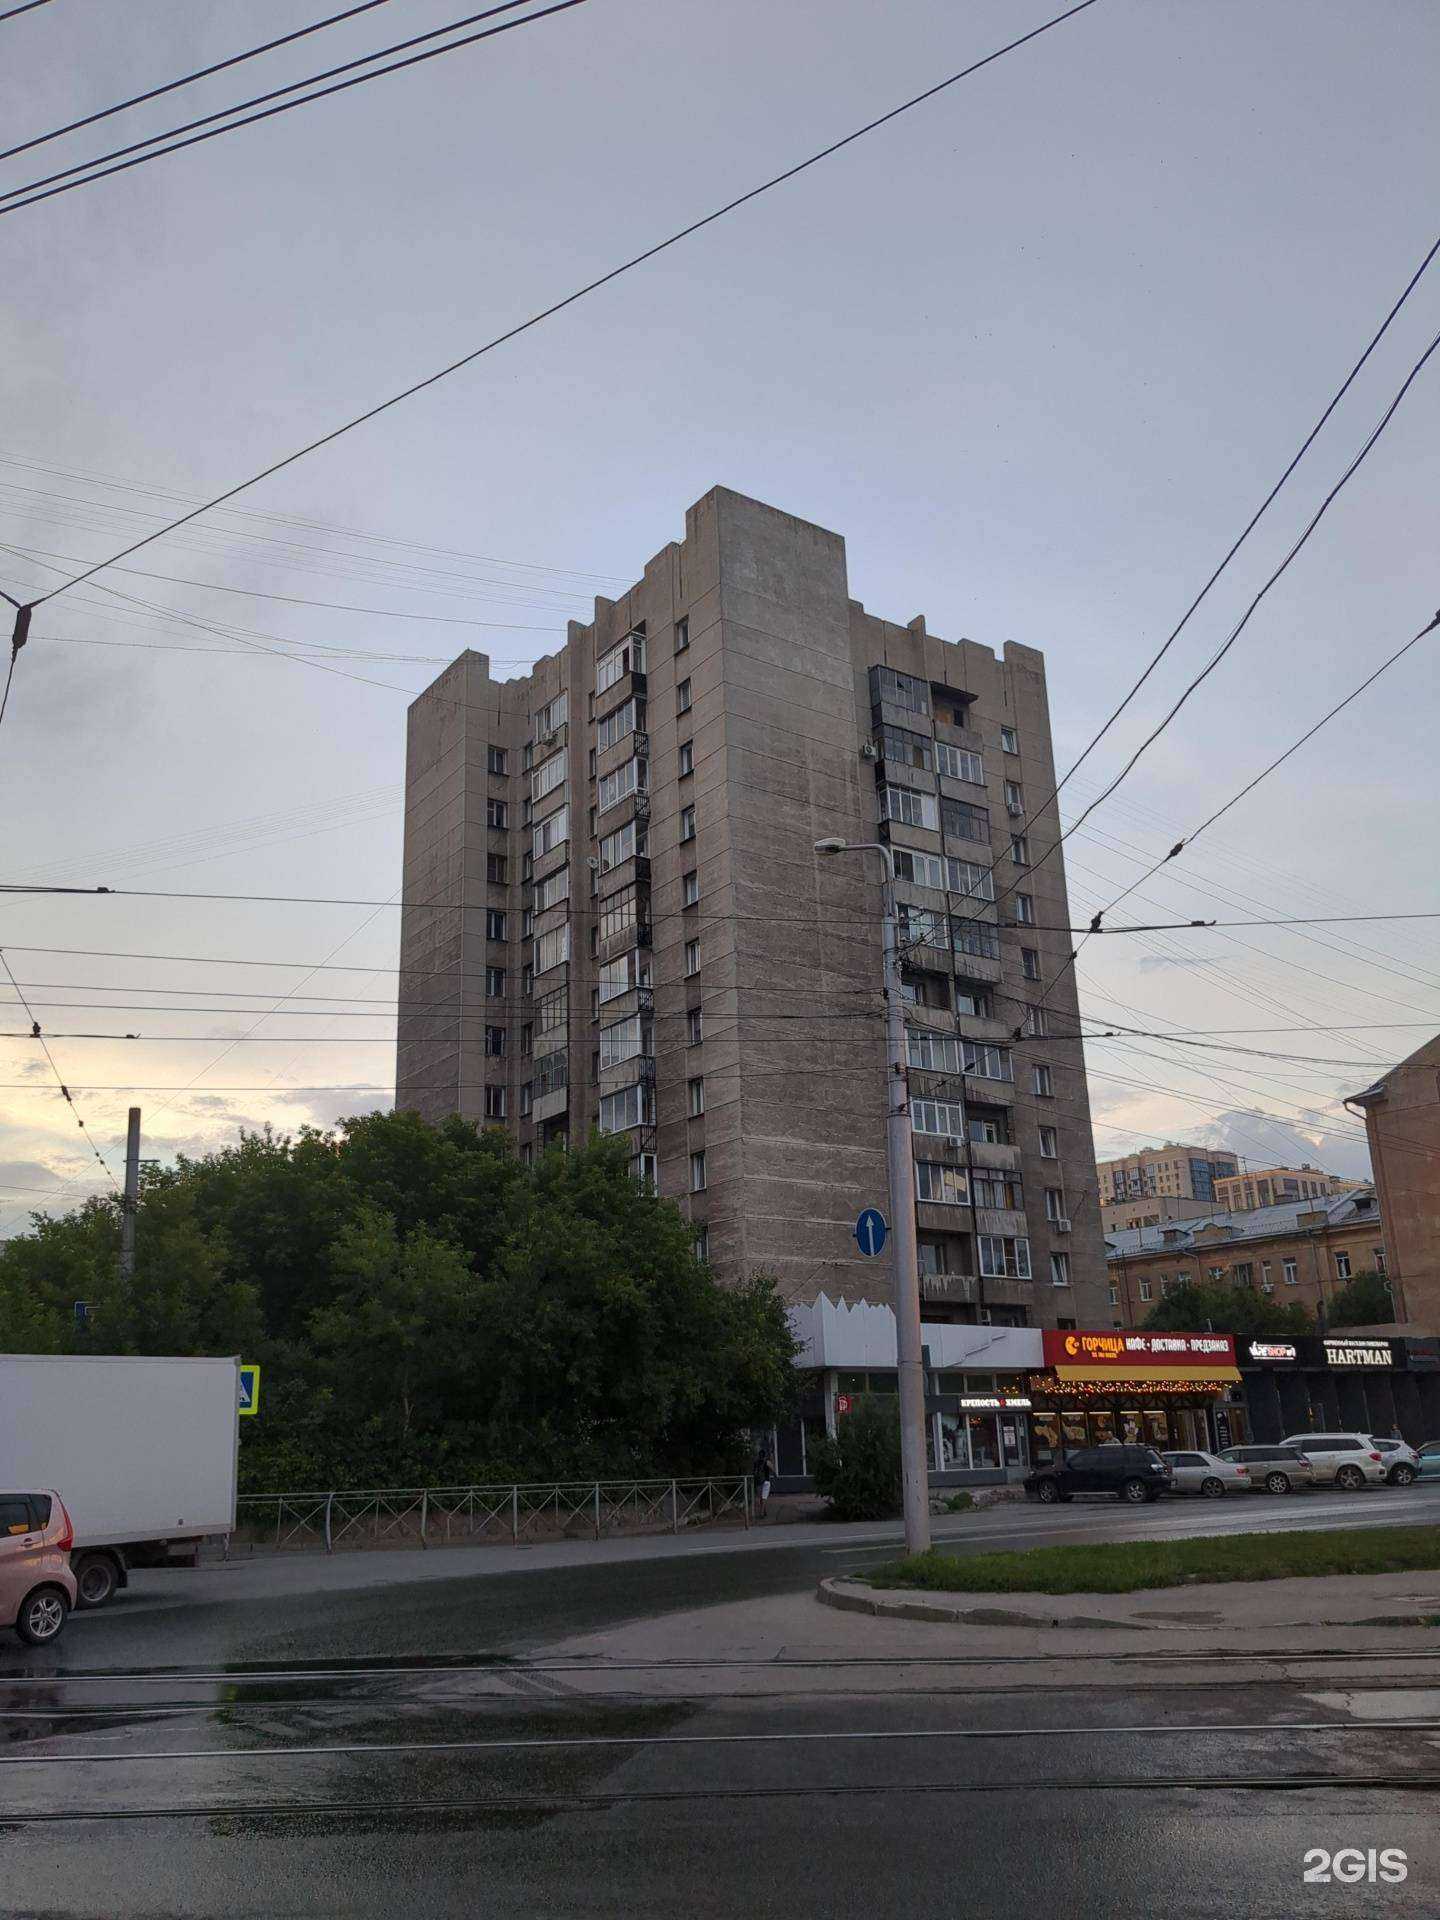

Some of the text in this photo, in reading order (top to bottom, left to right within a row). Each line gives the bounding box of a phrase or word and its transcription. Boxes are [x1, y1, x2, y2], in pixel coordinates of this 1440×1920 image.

[1082, 1336, 1124, 1353] ГОРЧИЦА
[1126, 1336, 1229, 1353] КАФЕ ДОСТАВКА ПРЕДЗАКАЗ
[1267, 1347, 1286, 1357] SHOP
[1326, 1349, 1392, 1364] HARTMAN
[961, 1399, 1032, 1407] КРЕПОСТЬ ХМЕЛЬ
